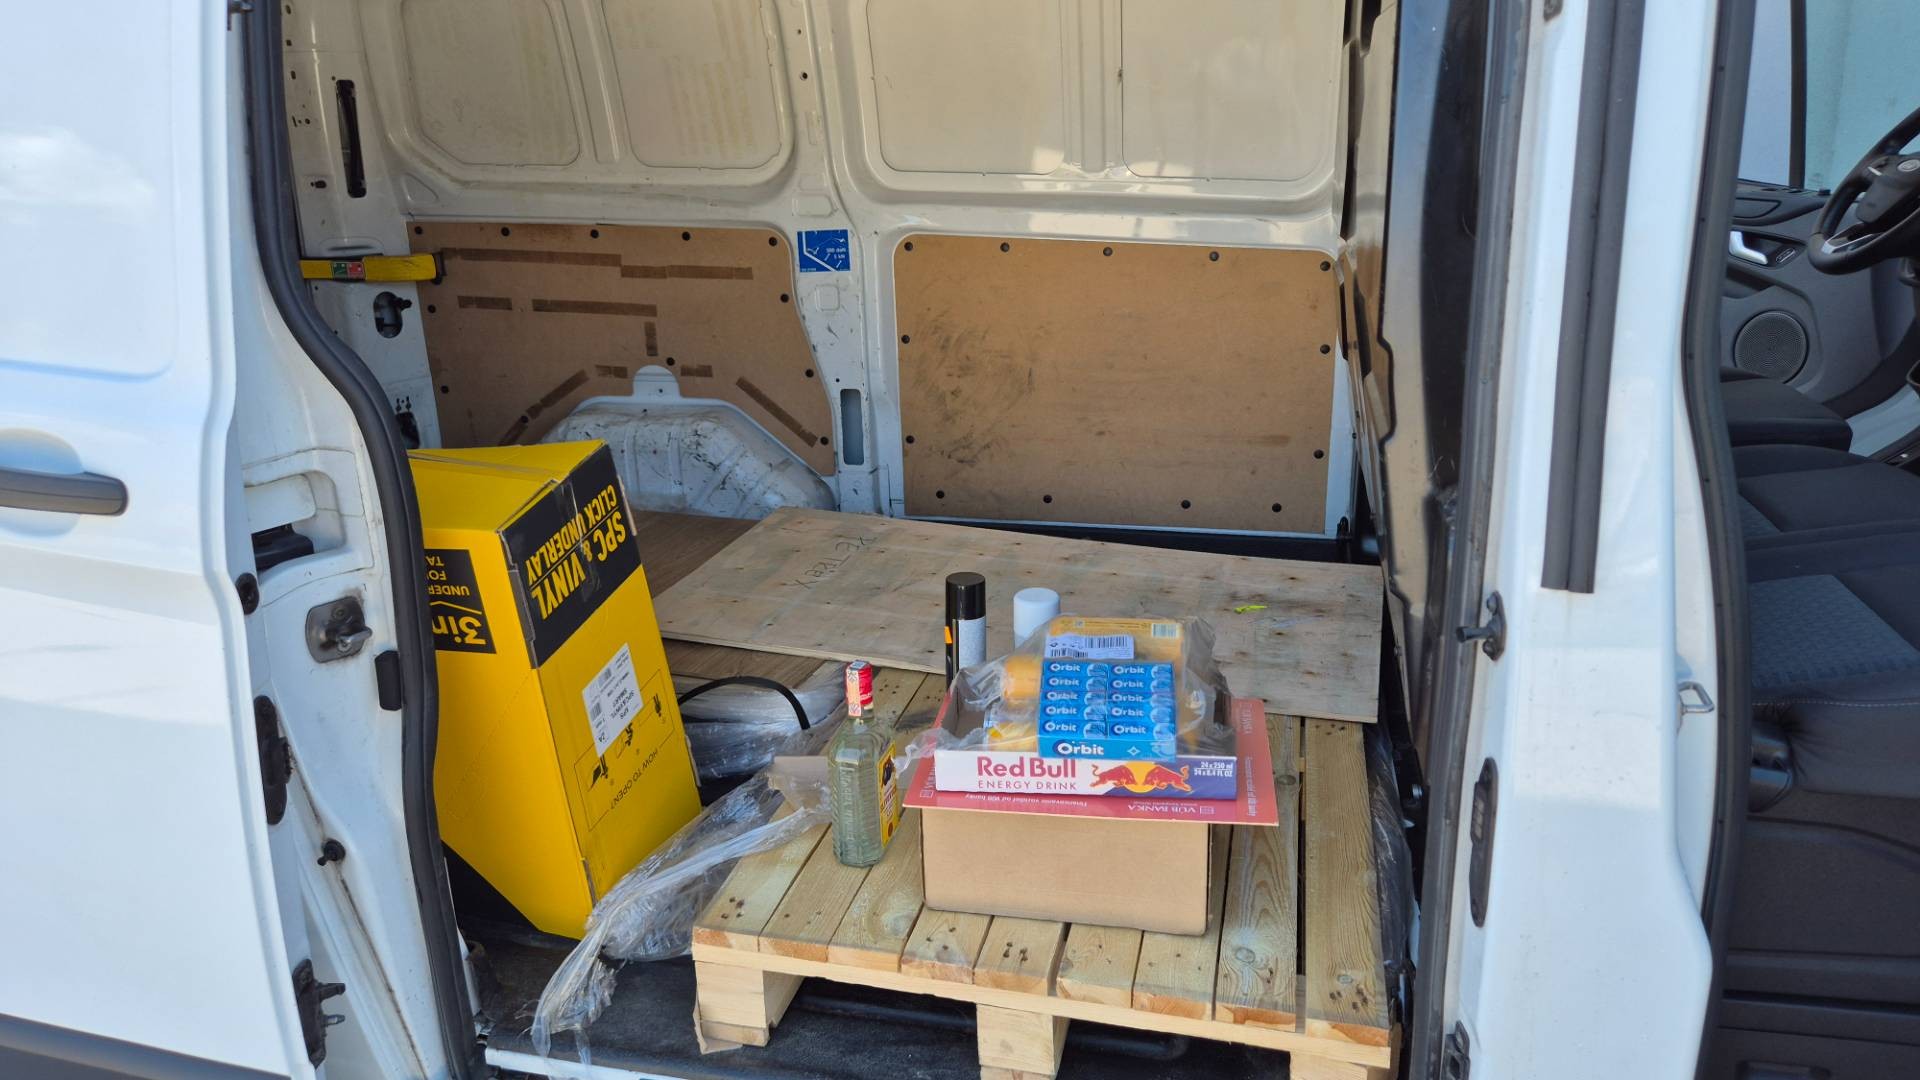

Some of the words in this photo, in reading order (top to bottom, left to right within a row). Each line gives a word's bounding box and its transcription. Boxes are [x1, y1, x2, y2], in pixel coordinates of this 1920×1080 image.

[584, 485, 617, 529] CLICK
[593, 511, 625, 561] SPC
[526, 512, 587, 586] UNDERLAY
[582, 540, 592, 562] &
[530, 551, 586, 620] VINYL
[1050, 663, 1080, 672] Orbit
[1113, 665, 1145, 675] Orbit
[1049, 677, 1080, 687] Orbit
[1112, 679, 1144, 688] Orbit
[1046, 691, 1078, 700] Orbit
[1111, 693, 1144, 702] Orbit
[1045, 705, 1077, 715] Orbit
[1111, 707, 1144, 717] Orbit
[1044, 721, 1077, 732] Orbit
[1113, 724, 1146, 734] Orbit
[1057, 742, 1104, 755] Orbit
[643, 748, 657, 769] HOW
[977, 756, 1025, 777] Red
[1029, 757, 1076, 778] Bull
[633, 768, 642, 782] TO
[978, 780, 1031, 790] ENERGY
[1036, 781, 1077, 790] DRINK
